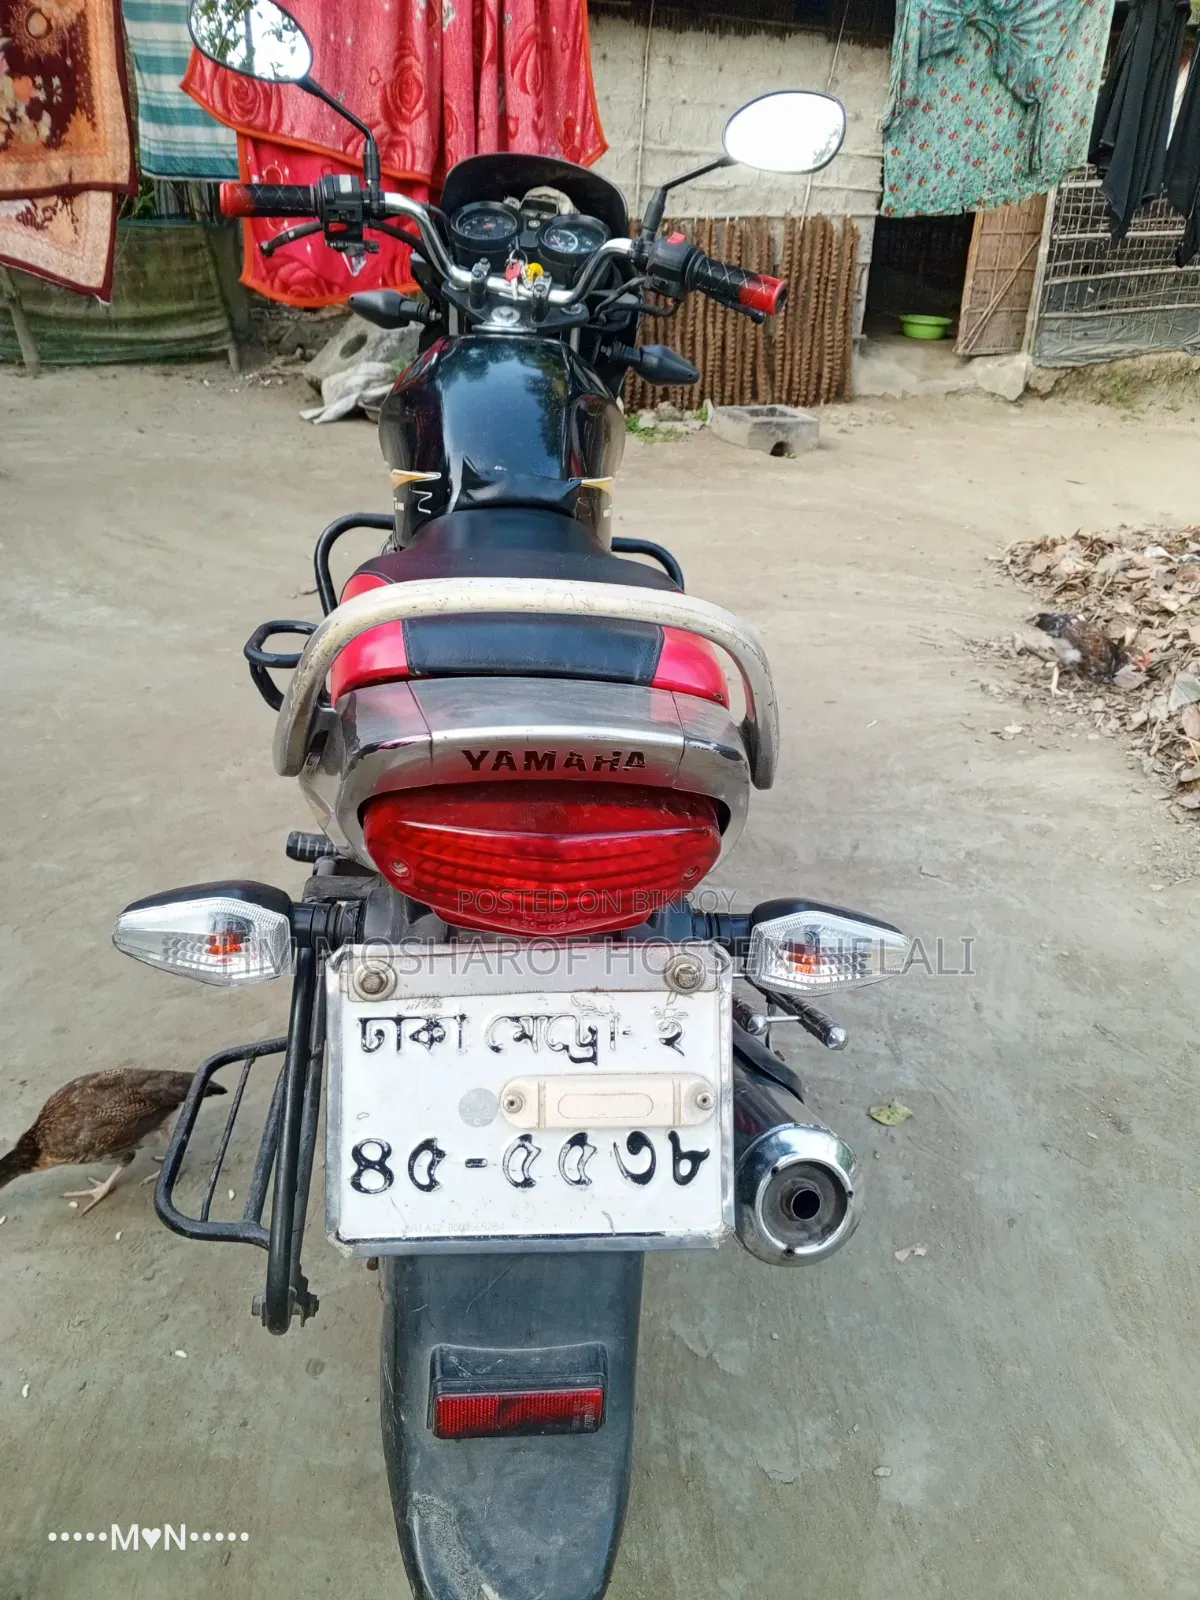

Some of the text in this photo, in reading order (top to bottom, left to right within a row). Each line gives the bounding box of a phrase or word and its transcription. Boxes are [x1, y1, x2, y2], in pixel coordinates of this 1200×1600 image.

[461, 750, 647, 772] YAMAHA
[356, 1013, 468, 1053] ঢাকা
[350, 1130, 711, 1195] ৪৫-৫৫৩৮
